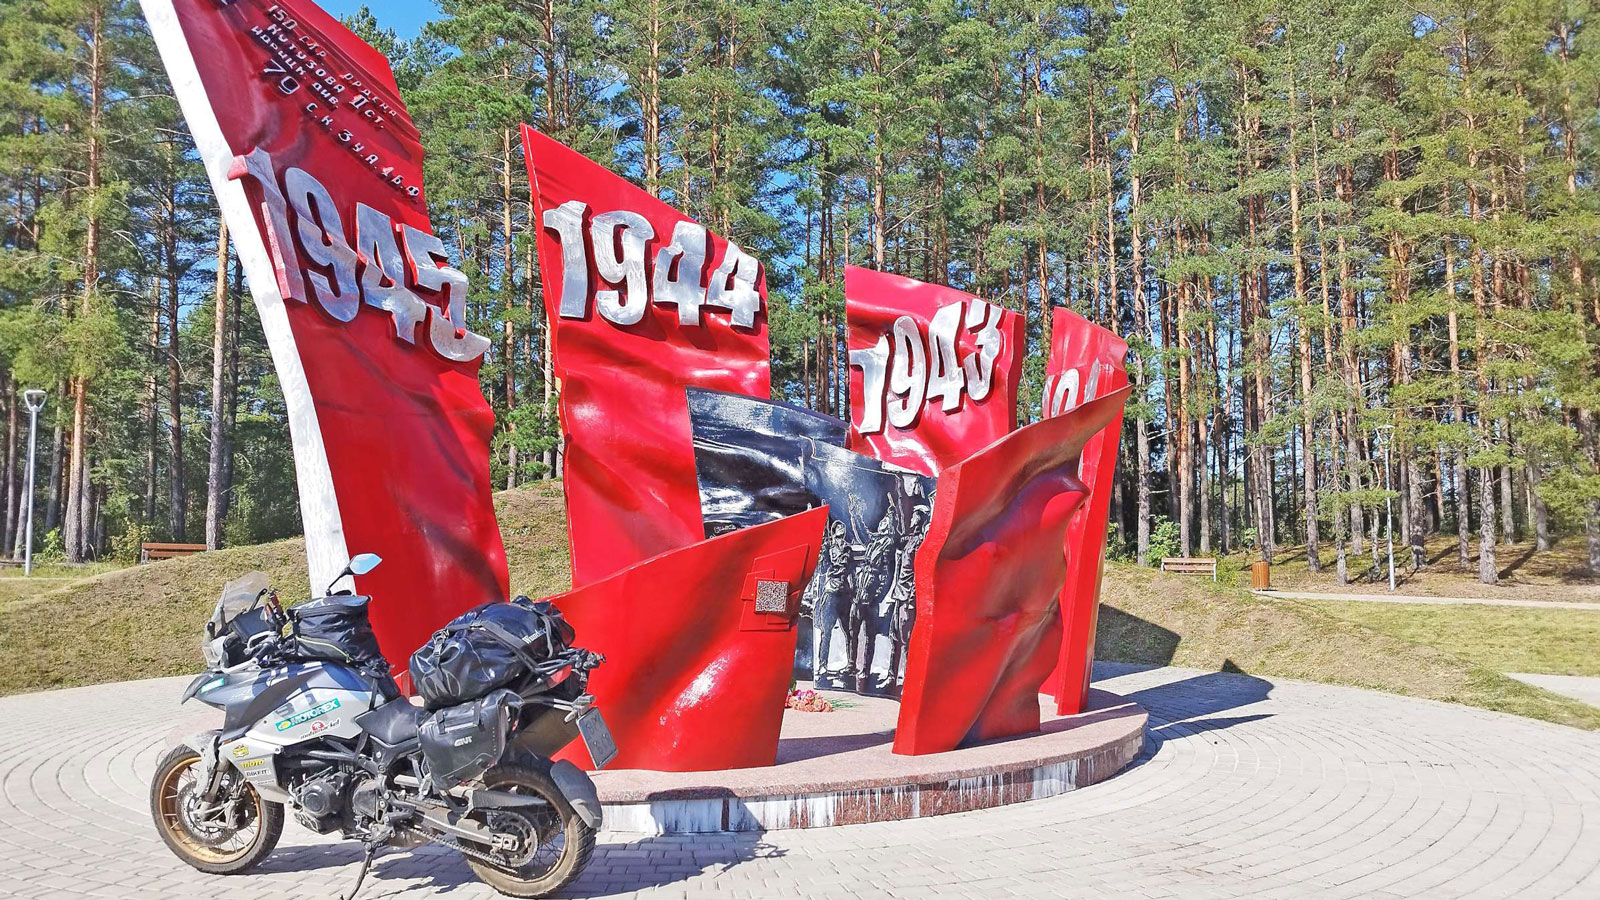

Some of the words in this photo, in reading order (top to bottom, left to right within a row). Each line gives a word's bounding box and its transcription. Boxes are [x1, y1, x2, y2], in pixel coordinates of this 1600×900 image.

[268, 4, 299, 31] 150
[264, 59, 300, 96] 79
[229, 146, 491, 362] 1945
[543, 200, 760, 328] 1944
[849, 299, 1003, 434] 1943
[289, 699, 338, 727] MOTOREX
